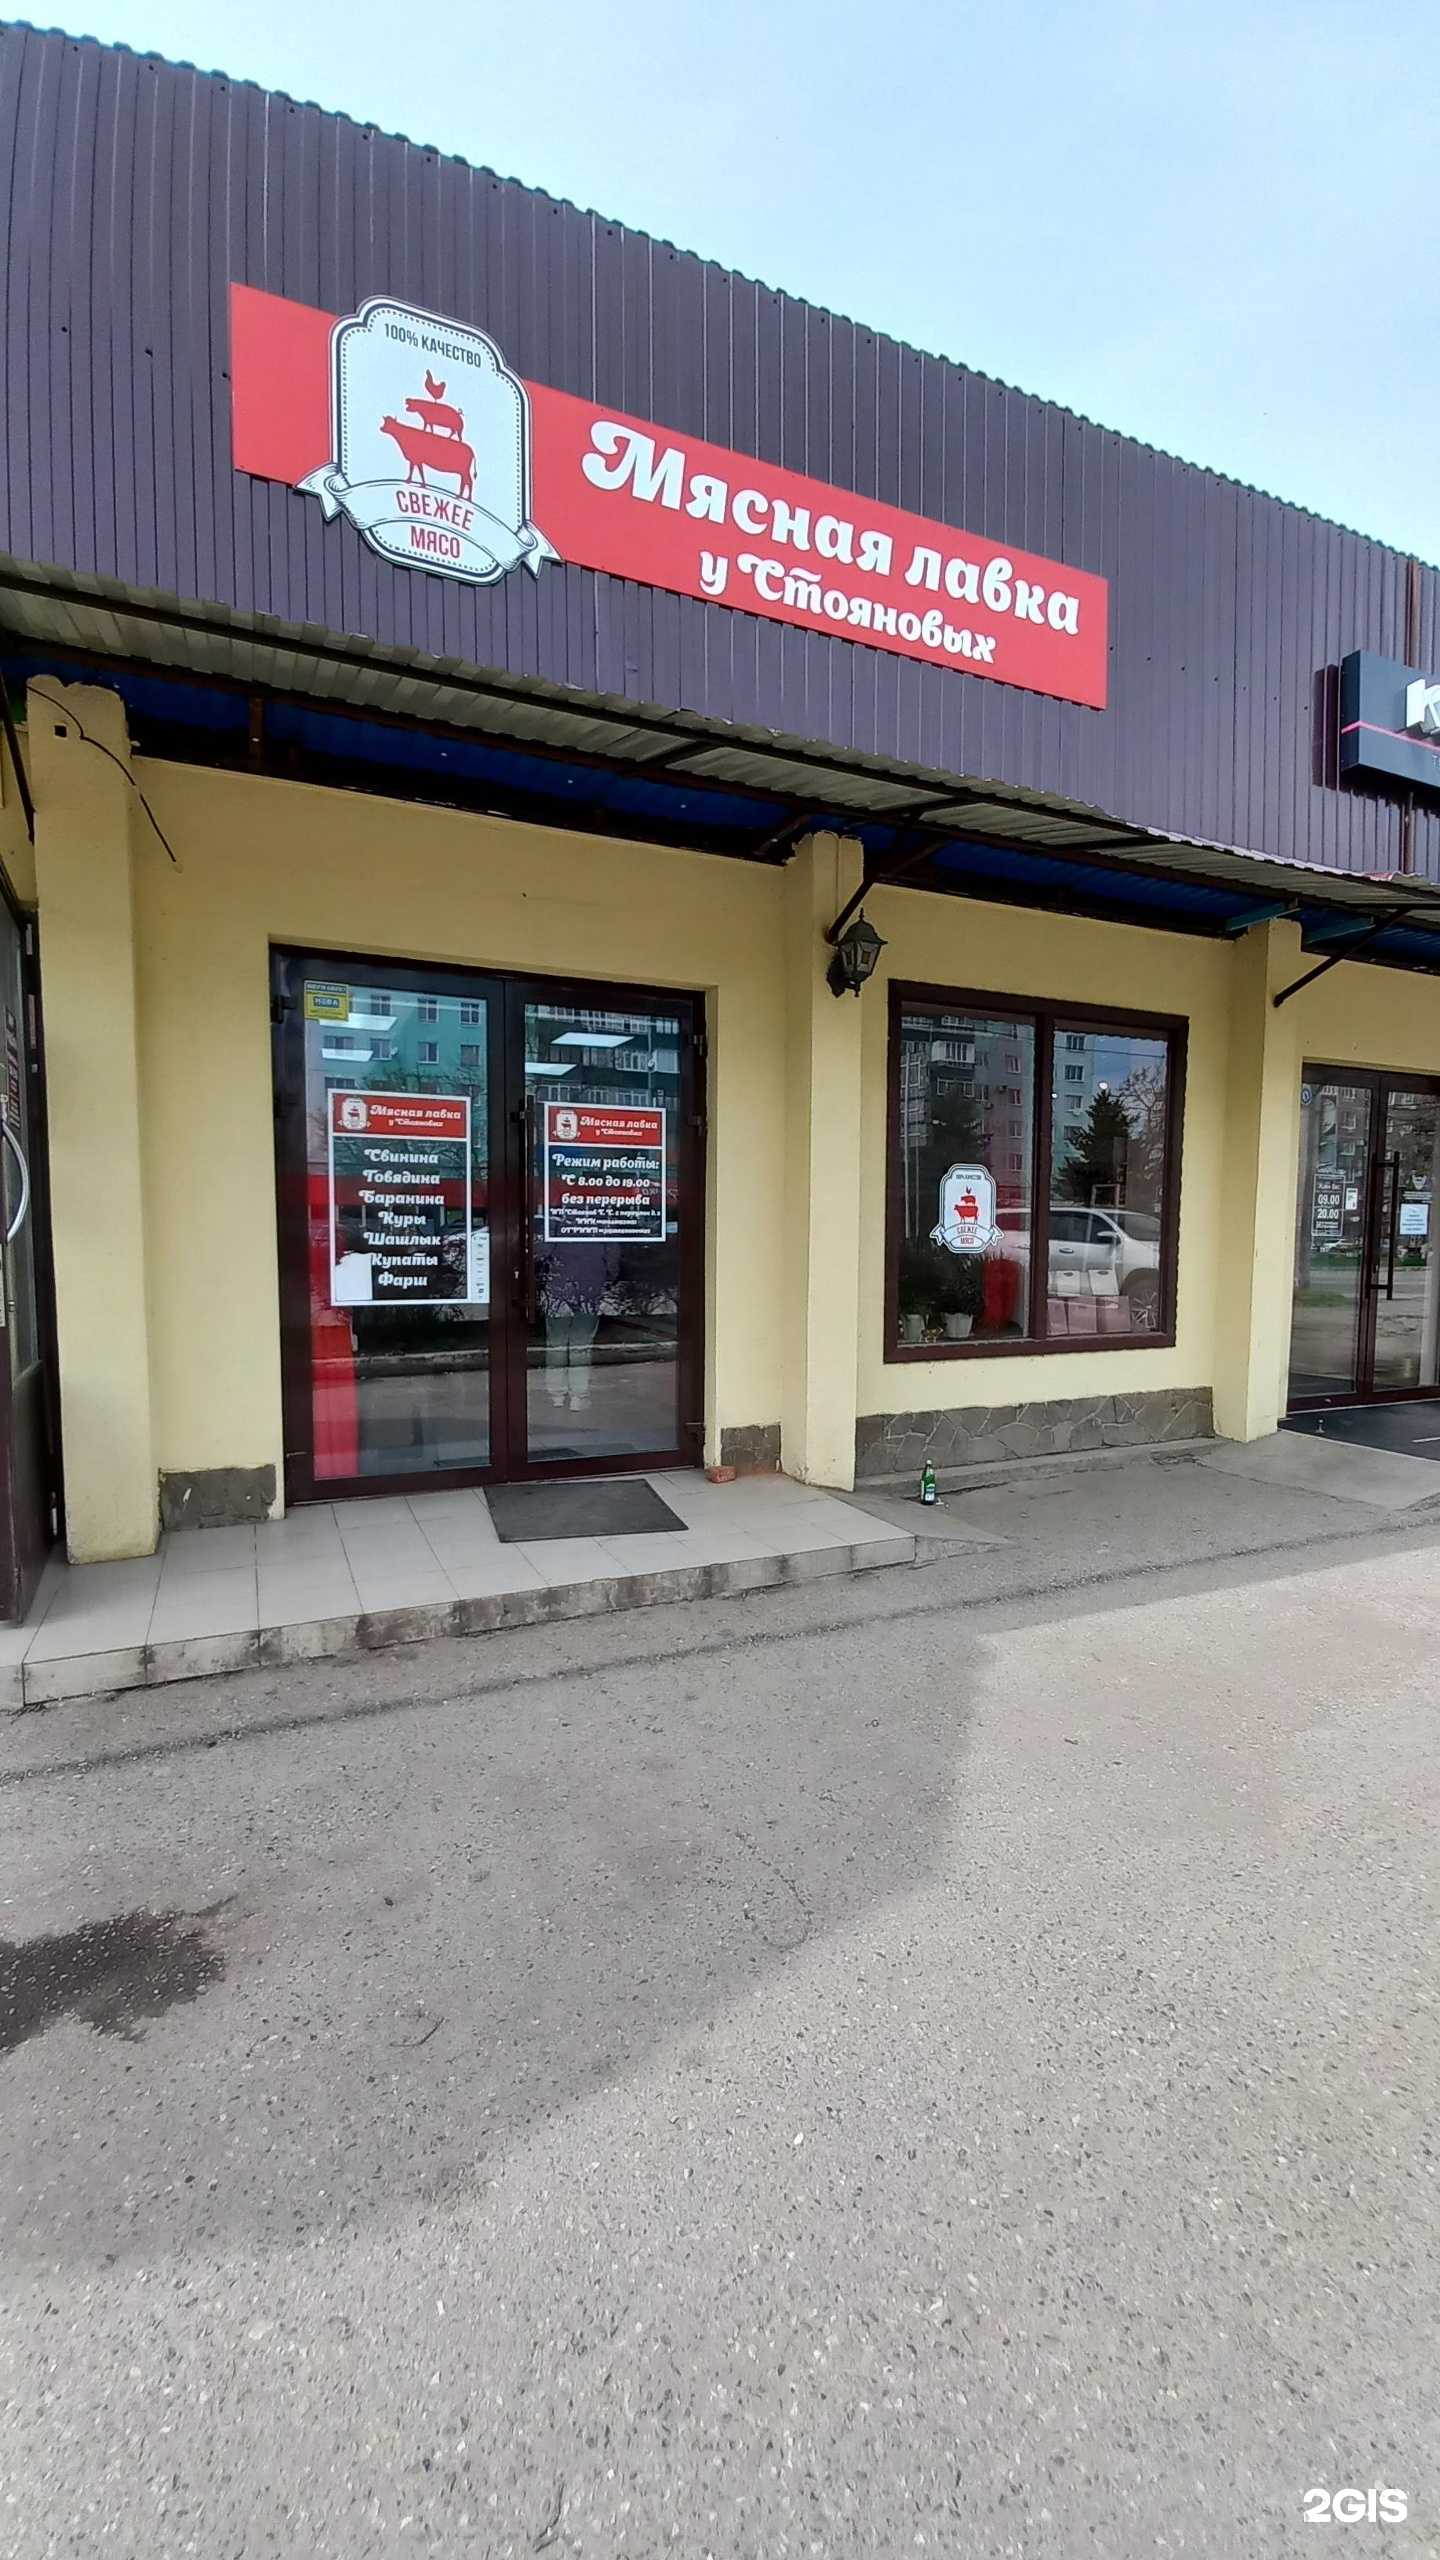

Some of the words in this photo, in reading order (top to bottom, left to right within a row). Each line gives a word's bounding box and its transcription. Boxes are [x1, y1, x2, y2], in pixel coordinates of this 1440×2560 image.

[385, 322, 419, 347] 100%
[421, 334, 482, 368] КАЧЕСТВО
[395, 490, 475, 532] СВЕЖЕЕ
[581, 421, 893, 577] Мясная
[904, 545, 1080, 636] лавка
[410, 525, 461, 559] МЯСО
[700, 550, 729, 595] у
[736, 553, 997, 664] Стояновых
[370, 1104, 423, 1119] Мясная
[424, 1108, 461, 1120] лавка
[580, 1116, 625, 1128] Мясная
[626, 1119, 658, 1129] лавка
[364, 1148, 439, 1164] Свинина
[552, 1153, 601, 1168] Режим
[602, 1156, 660, 1171] работы:
[362, 1168, 441, 1185] Говядина
[561, 1173, 576, 1186] С
[578, 1176, 603, 1187] 8.00
[605, 1175, 621, 1187] до
[622, 1178, 650, 1188] 19.00
[358, 1189, 445, 1207] Баранина
[561, 1193, 584, 1205] без
[586, 1193, 650, 1208] перерыва
[1318, 1194, 1340, 1205] 09.00
[378, 1211, 427, 1228] Куры
[1317, 1208, 1339, 1219] 20.00
[363, 1231, 442, 1246] Шашлык
[368, 1252, 439, 1267] Купаты
[378, 1270, 428, 1289] Фарш
